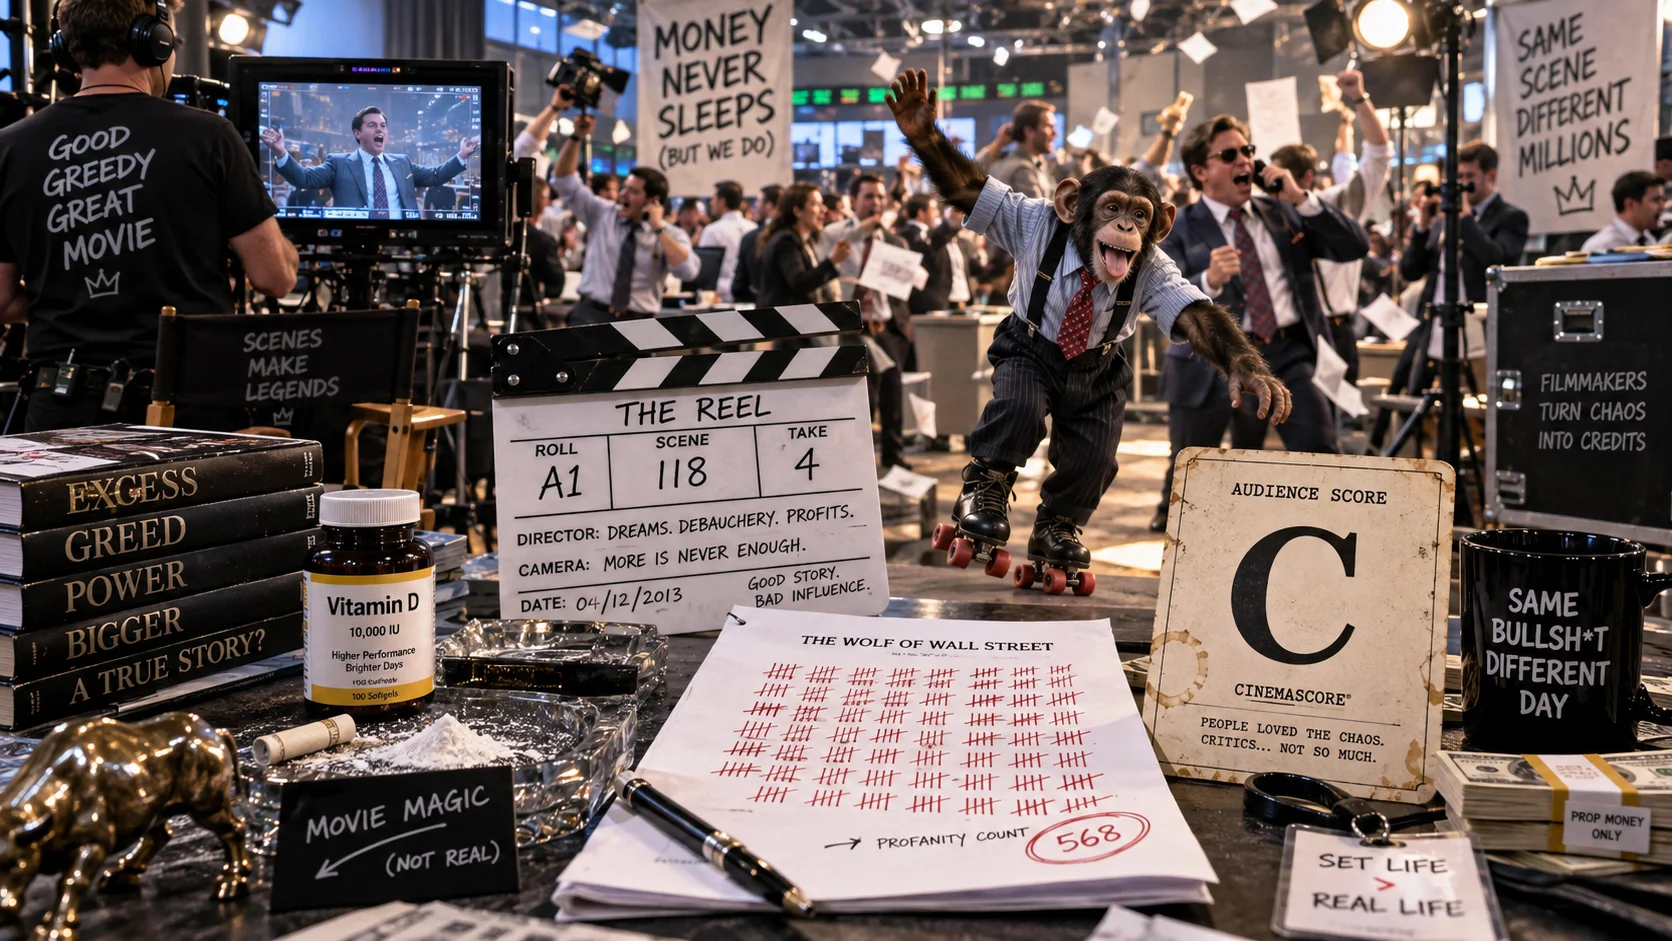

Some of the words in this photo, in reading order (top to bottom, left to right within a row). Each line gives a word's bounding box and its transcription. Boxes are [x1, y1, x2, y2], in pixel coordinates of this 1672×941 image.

[655, 3, 773, 60] MONEY
[1517, 11, 1584, 63] SAME
[663, 51, 766, 98] NEVER
[1519, 47, 1597, 100] SCENE
[658, 88, 775, 140] SLEEPS
[1516, 76, 1632, 139] DIFFERENT
[48, 126, 131, 161] GOOD
[658, 144, 702, 171] (BUT
[707, 138, 734, 161] WE
[741, 130, 775, 158] DO)
[1518, 118, 1631, 178] MILLIONS
[43, 148, 156, 197] GREEDY
[46, 184, 144, 233] GREAT
[63, 218, 156, 271] MOVIE
[242, 328, 323, 353] SCENES
[247, 355, 309, 378] MAKE
[245, 376, 340, 401] LEGENDS
[1540, 371, 1647, 393] FILMMAKERS
[615, 400, 677, 427] THE
[697, 394, 772, 422] REEL
[1538, 401, 1582, 421] TURN
[1589, 401, 1647, 421] CHAOS
[655, 433, 710, 450] SCENE
[787, 425, 828, 440] TAKE
[1538, 431, 1574, 450] INTO
[1580, 431, 1647, 451] CREDITS
[534, 443, 579, 458] ROLL
[794, 447, 820, 481] 4
[538, 464, 583, 501] A1
[657, 456, 708, 490] 118
[66, 466, 199, 515] EXCESS
[1231, 482, 1320, 502] AUDIENCE
[1330, 488, 1388, 505] SCORE
[64, 514, 187, 563] GREED
[516, 527, 600, 547] DIRECTOR:
[606, 521, 672, 541] DREAMS.
[678, 510, 779, 535] DEBAUCHERY.
[786, 504, 855, 524] PROFITS.
[518, 560, 590, 578] CAMERA:
[603, 553, 647, 573] MORE
[654, 550, 670, 566] IS
[677, 545, 729, 565] NEVER
[736, 538, 807, 559] ENOUGH.
[64, 560, 188, 613] POWER
[747, 573, 786, 591] GOOD
[792, 566, 841, 585] STORY.
[754, 592, 784, 608] BAD
[791, 578, 871, 602] INFLUENCE.
[327, 595, 403, 616] Vitamin
[407, 592, 420, 612] D
[520, 596, 567, 613] DATE:
[575, 586, 683, 616] 04/12/2013
[1231, 525, 1358, 665] C
[1508, 587, 1579, 617] SAME
[65, 606, 184, 661] BIGGER
[349, 625, 386, 639] 10,000
[389, 623, 400, 636] IU
[801, 635, 837, 646] THE
[843, 637, 895, 648] WOLF
[899, 639, 924, 649] OF
[929, 640, 979, 651] WALL
[984, 641, 1054, 652] STREET
[69, 678, 91, 706] A
[98, 654, 170, 696] TRUE
[178, 627, 266, 674] STORY?
[331, 650, 361, 662] Higher
[362, 647, 416, 660] Performance
[345, 662, 382, 675] Brighter
[383, 661, 404, 671] Days
[1486, 650, 1611, 687] DIFFERENT
[352, 692, 366, 701] 100
[1519, 689, 1569, 719] DAY
[1200, 717, 1249, 733] PEOPLE
[1256, 722, 1298, 738] LOVED
[1305, 728, 1331, 742] THE
[1338, 731, 1385, 747] CHAOS.
[1200, 734, 1271, 753] CRITICS...
[1279, 742, 1305, 756] NOT
[1313, 745, 1331, 758] SO
[1337, 748, 1378, 764] MUCH.
[305, 804, 387, 844] MOVIE
[403, 785, 490, 823] MAGIC
[1570, 810, 1602, 824] PROP
[1604, 814, 1646, 828] MONEY
[877, 832, 967, 851] PROFANITY
[976, 827, 1030, 843] COUNT
[1056, 823, 1122, 853] 568
[1591, 828, 1623, 842] ONLY
[385, 851, 436, 878] (NOT
[444, 839, 501, 869] REAL)
[1318, 853, 1373, 871] SET
[1386, 858, 1449, 875] LIFE
[1312, 892, 1387, 914] REAL
[1400, 898, 1466, 918] LIFE
